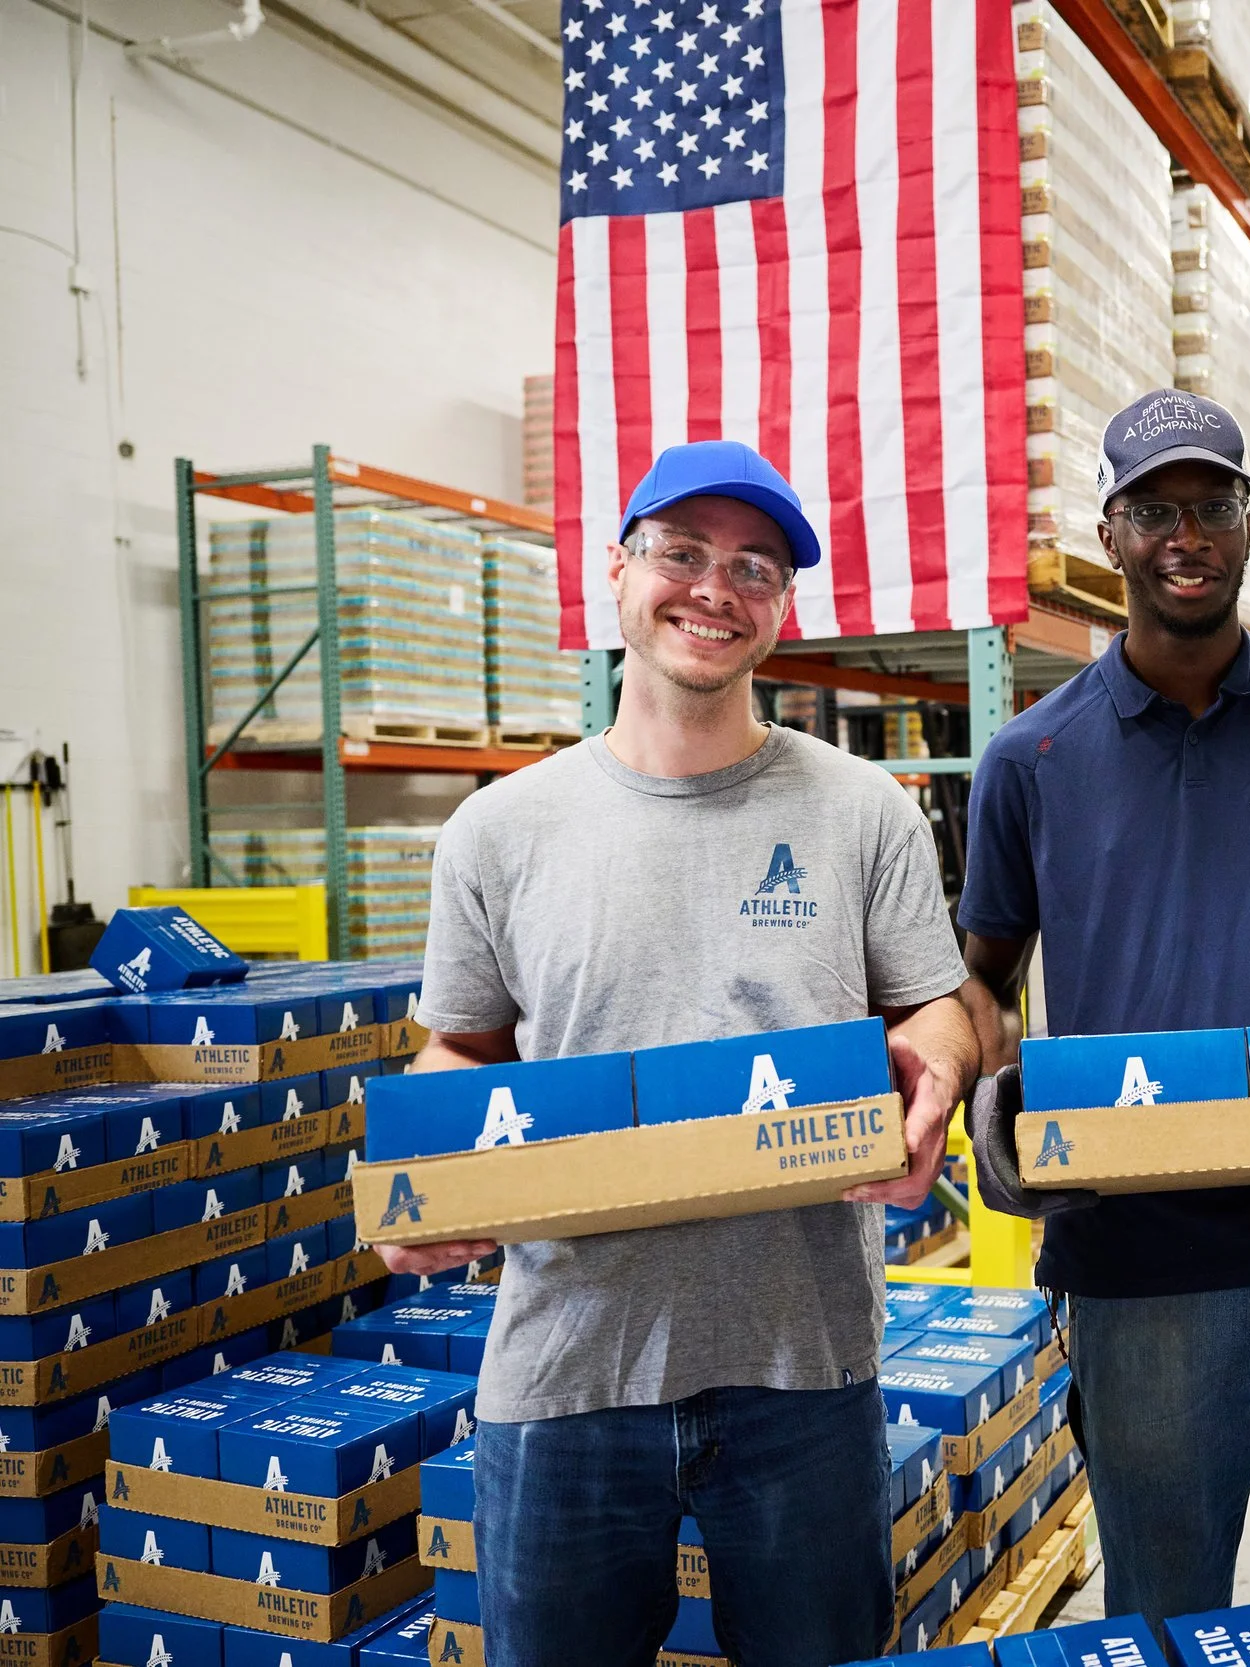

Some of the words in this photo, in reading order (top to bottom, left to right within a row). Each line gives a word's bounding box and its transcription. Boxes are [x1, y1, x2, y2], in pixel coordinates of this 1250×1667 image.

[1142, 396, 1196, 416] BREWING
[1123, 404, 1221, 442] ATHLETIC
[1142, 420, 1204, 441] COMPANY
[740, 900, 817, 917] ATHLETIC
[752, 919, 793, 928] BREWING
[172, 916, 230, 959] ATHLETIC
[118, 964, 147, 991] ATHLETIC
[330, 1032, 372, 1052] ATHLETIC
[55, 1054, 111, 1074] ATHLETIC
[195, 1050, 250, 1063] ATHLETIC
[272, 1118, 318, 1142] ATHLETIC
[756, 1108, 884, 1150] ATHLETIC
[780, 1148, 846, 1169] BREWING
[121, 1157, 178, 1184] ATHLETIC
[206, 1213, 258, 1242] ATHLETIC
[276, 1272, 323, 1299] ATHLETIC
[392, 1308, 472, 1318] ATHLETIC
[128, 1318, 186, 1352] ATHLETIC
[232, 1370, 312, 1386] ATHLETIC
[340, 1384, 424, 1402] ATHLETIC
[141, 1403, 224, 1420] ATHLETIC
[252, 1419, 342, 1438] ATHLETIC
[266, 1496, 326, 1521] ATHLETIC
[276, 1518, 308, 1532] BREWING
[0, 1551, 37, 1568] LETIC
[258, 1592, 318, 1618] ATHLETIC
[268, 1614, 300, 1628] BREWING
[0, 1639, 36, 1656] LETIC
[1195, 1626, 1247, 1667] ETIC
